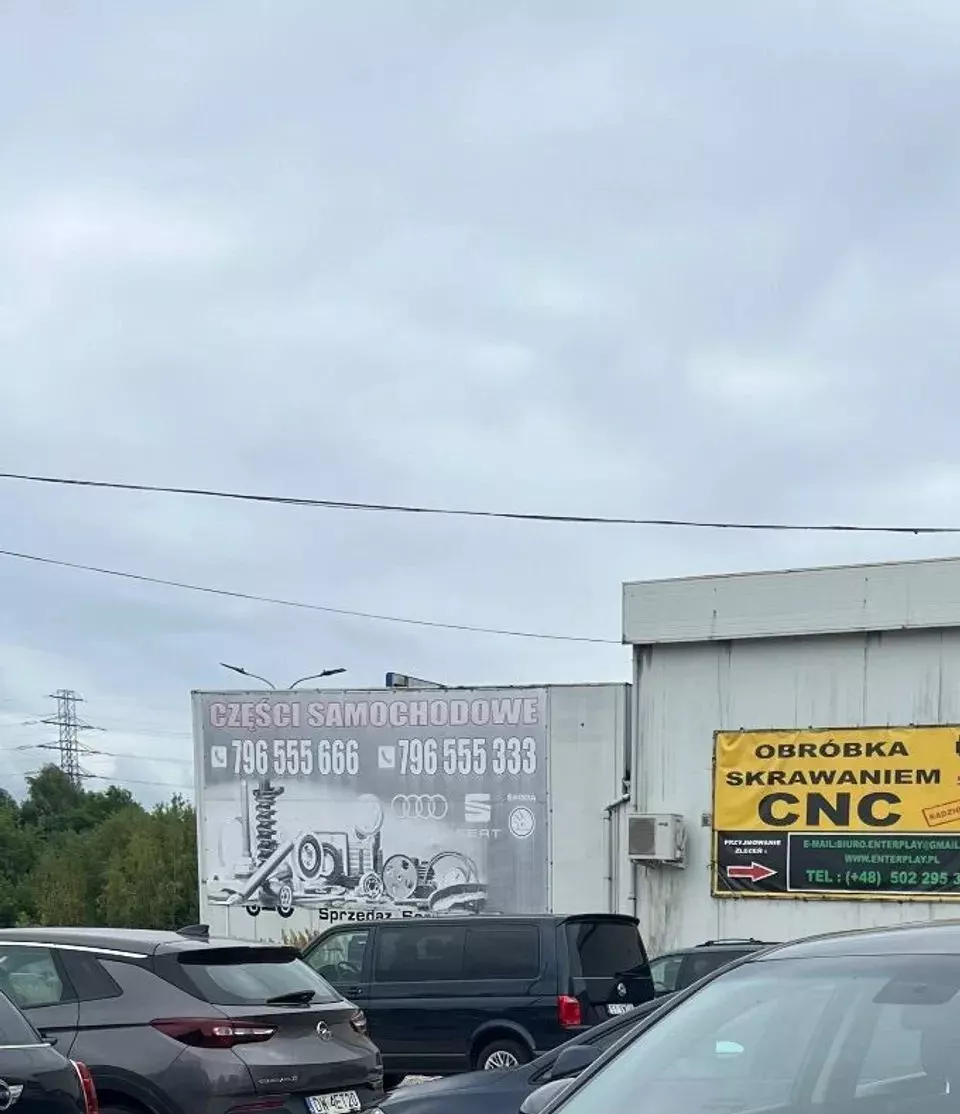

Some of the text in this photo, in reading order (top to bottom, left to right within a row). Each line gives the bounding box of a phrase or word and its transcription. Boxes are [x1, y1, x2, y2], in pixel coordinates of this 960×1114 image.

[209, 697, 539, 733] CZĘŚCI SAMOCHODOWE
[231, 739, 360, 775] 796 555 666
[398, 736, 537, 775] 796 555 333
[755, 739, 909, 759] OBRÓBKA
[726, 768, 941, 786] SKRAWANIEM
[758, 792, 902, 827] CNC
[805, 869, 833, 884] TEL
[845, 870, 881, 888] (+48)
[890, 871, 917, 885] 502
[921, 871, 948, 886] 295
